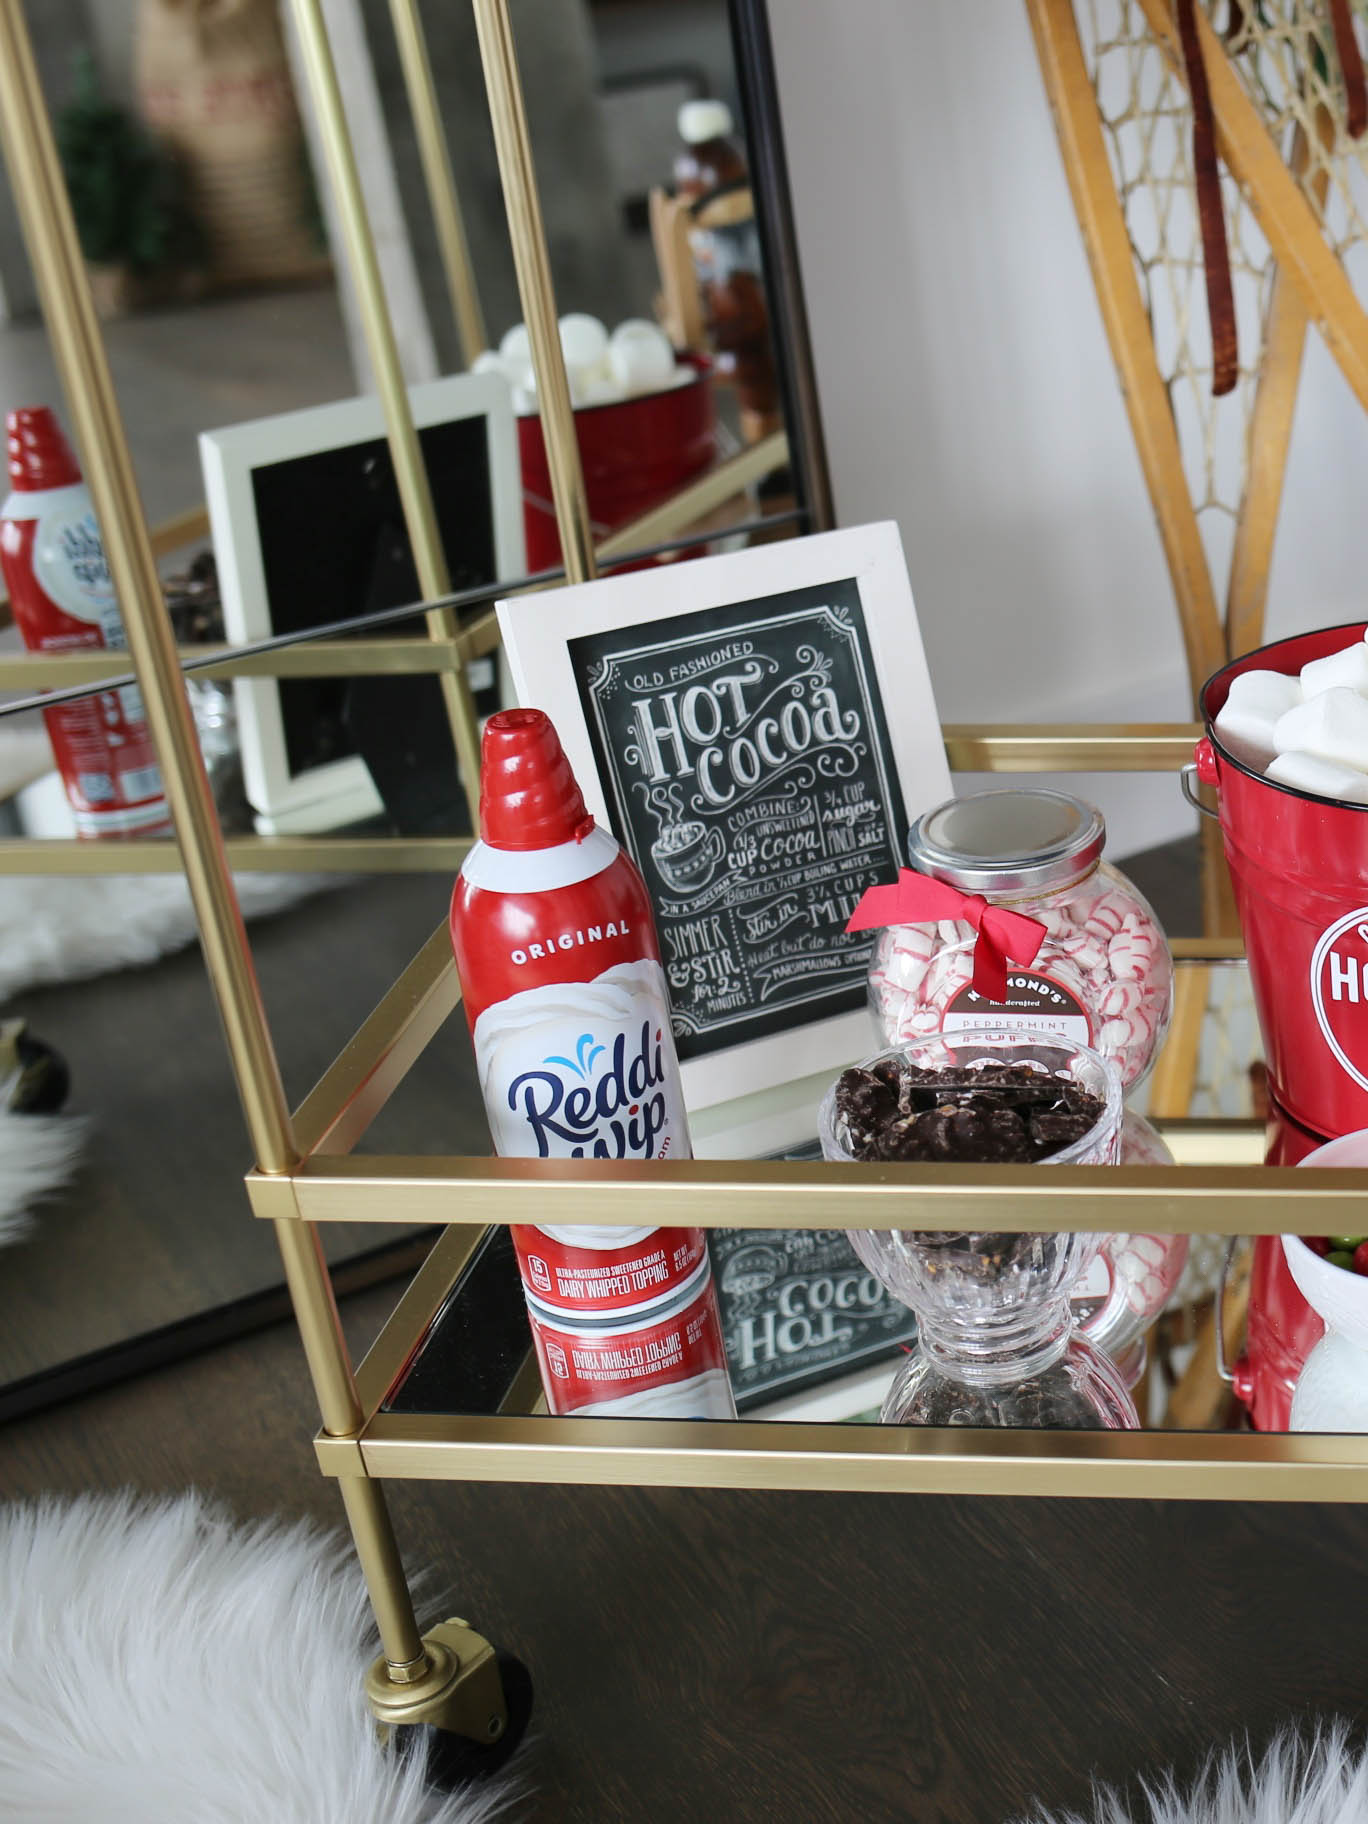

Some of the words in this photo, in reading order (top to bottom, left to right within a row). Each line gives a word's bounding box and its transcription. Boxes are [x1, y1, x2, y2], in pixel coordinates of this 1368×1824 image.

[633, 671, 664, 689] OLD
[669, 641, 754, 679] FASHIONED
[631, 661, 764, 784] HOT
[843, 781, 865, 803] CUP
[822, 800, 881, 827] sugar
[857, 827, 884, 847] SALT
[727, 849, 758, 869] CUP
[749, 851, 816, 876] POWDER
[834, 871, 879, 894] CUPS
[670, 904, 679, 914] IN
[682, 904, 689, 913] A
[778, 901, 798, 918] in
[510, 920, 630, 965] ORIGINAL
[664, 915, 728, 961] SIMMER
[668, 961, 690, 988] &
[717, 976, 741, 996] 2
[707, 991, 746, 1014] MINUTES
[967, 977, 1062, 1003] HMOND'S
[963, 1020, 1068, 1031] PEPPERMINT
[508, 1020, 665, 1158] Reddi
[532, 1258, 543, 1274] 15
[555, 1266, 610, 1279] ULTRA-PASTEURIZED
[610, 1260, 643, 1276] SWEETENED
[643, 1252, 661, 1267] GRADE
[660, 1249, 666, 1259] A
[557, 1278, 587, 1298] DAIRY
[586, 1275, 631, 1298] WHIPPED
[631, 1260, 669, 1291] TOPPING
